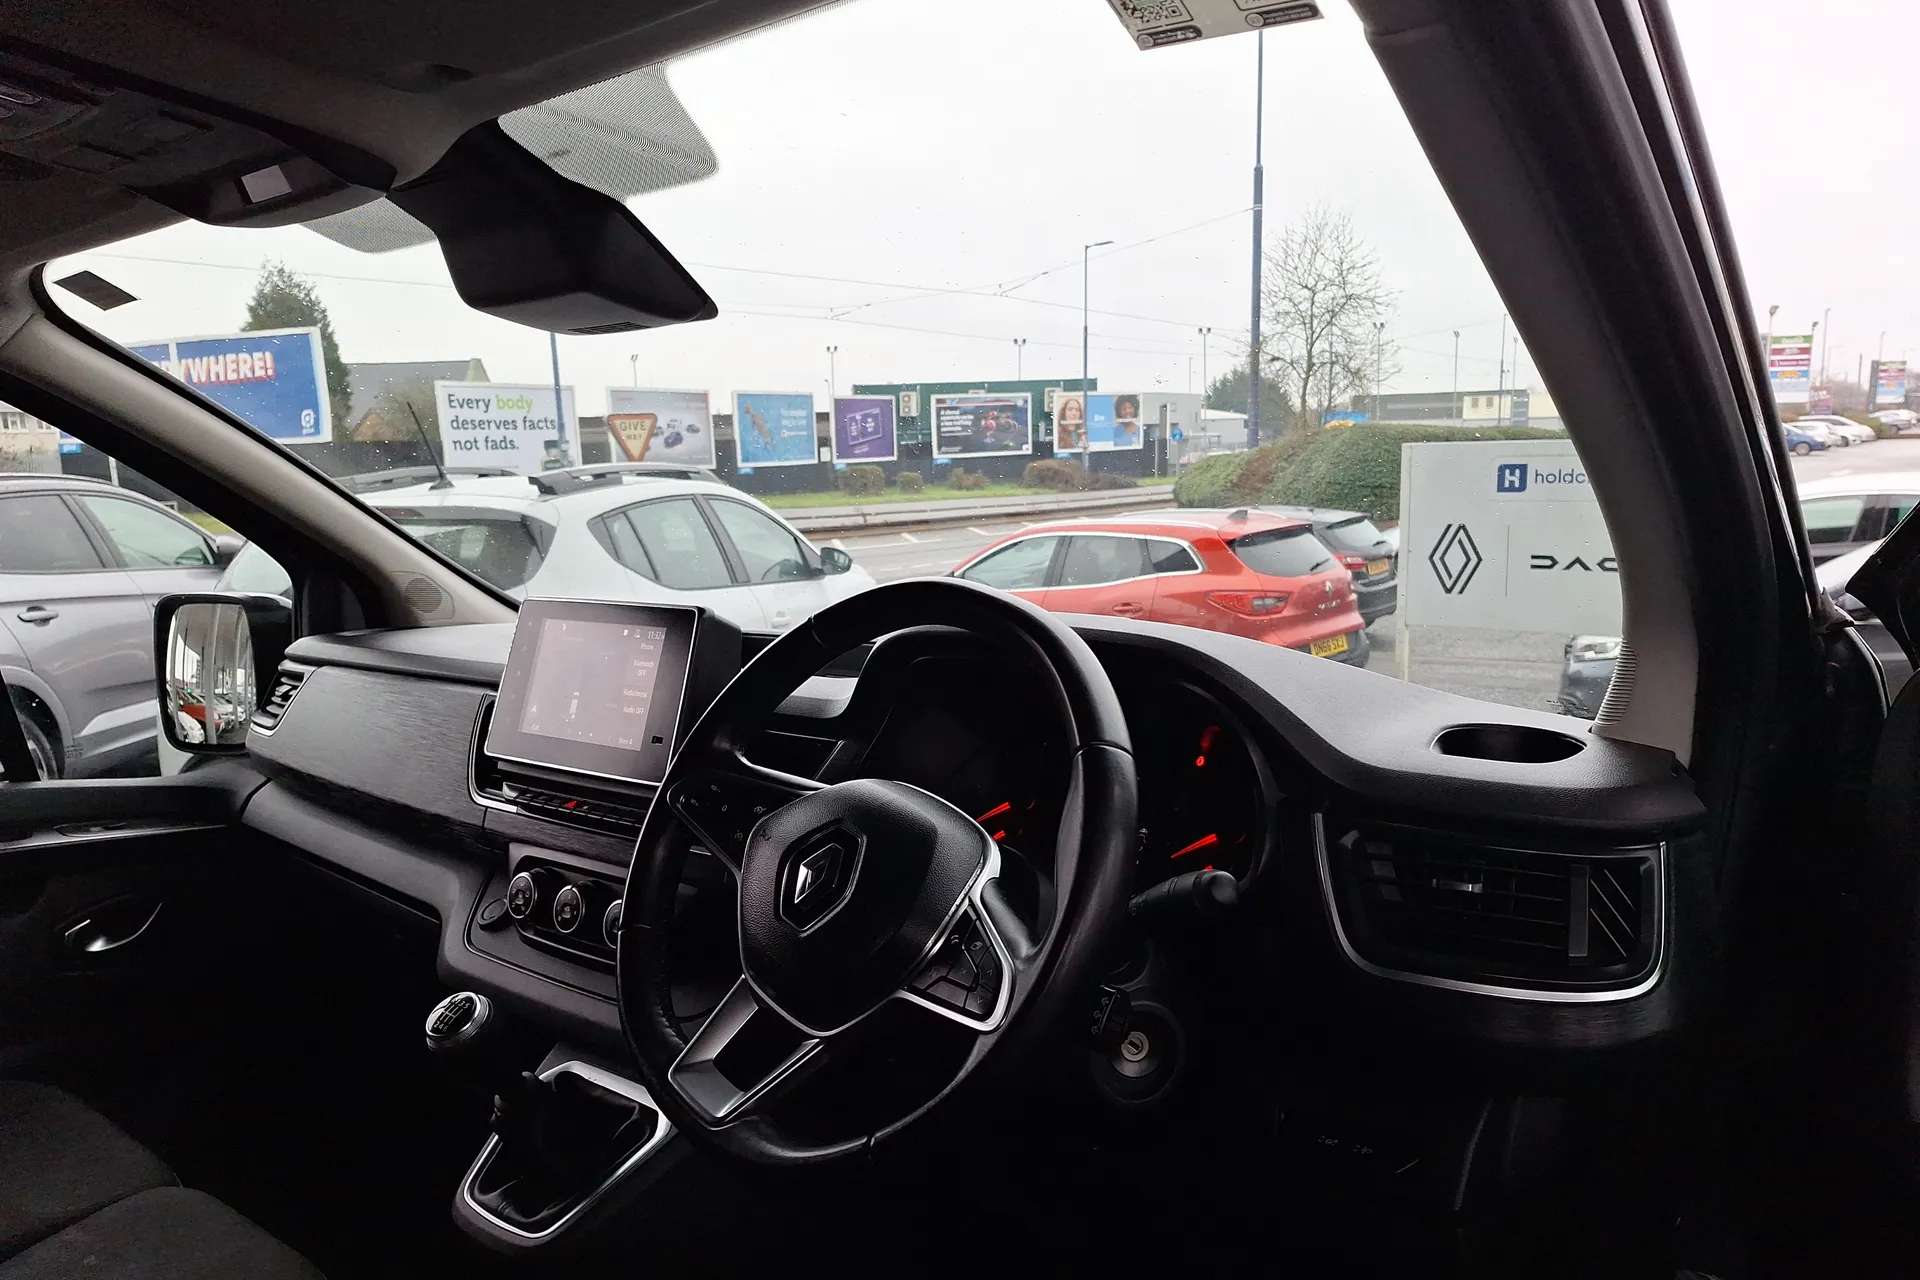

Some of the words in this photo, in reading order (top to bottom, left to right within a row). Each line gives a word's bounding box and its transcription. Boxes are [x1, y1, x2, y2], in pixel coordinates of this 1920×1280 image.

[151, 351, 276, 384] YWHERE!
[447, 393, 491, 413] Every
[495, 395, 534, 413] body
[450, 415, 518, 431] deserves
[620, 421, 647, 432] GIVE
[453, 438, 480, 451] not
[484, 436, 520, 451] fads.
